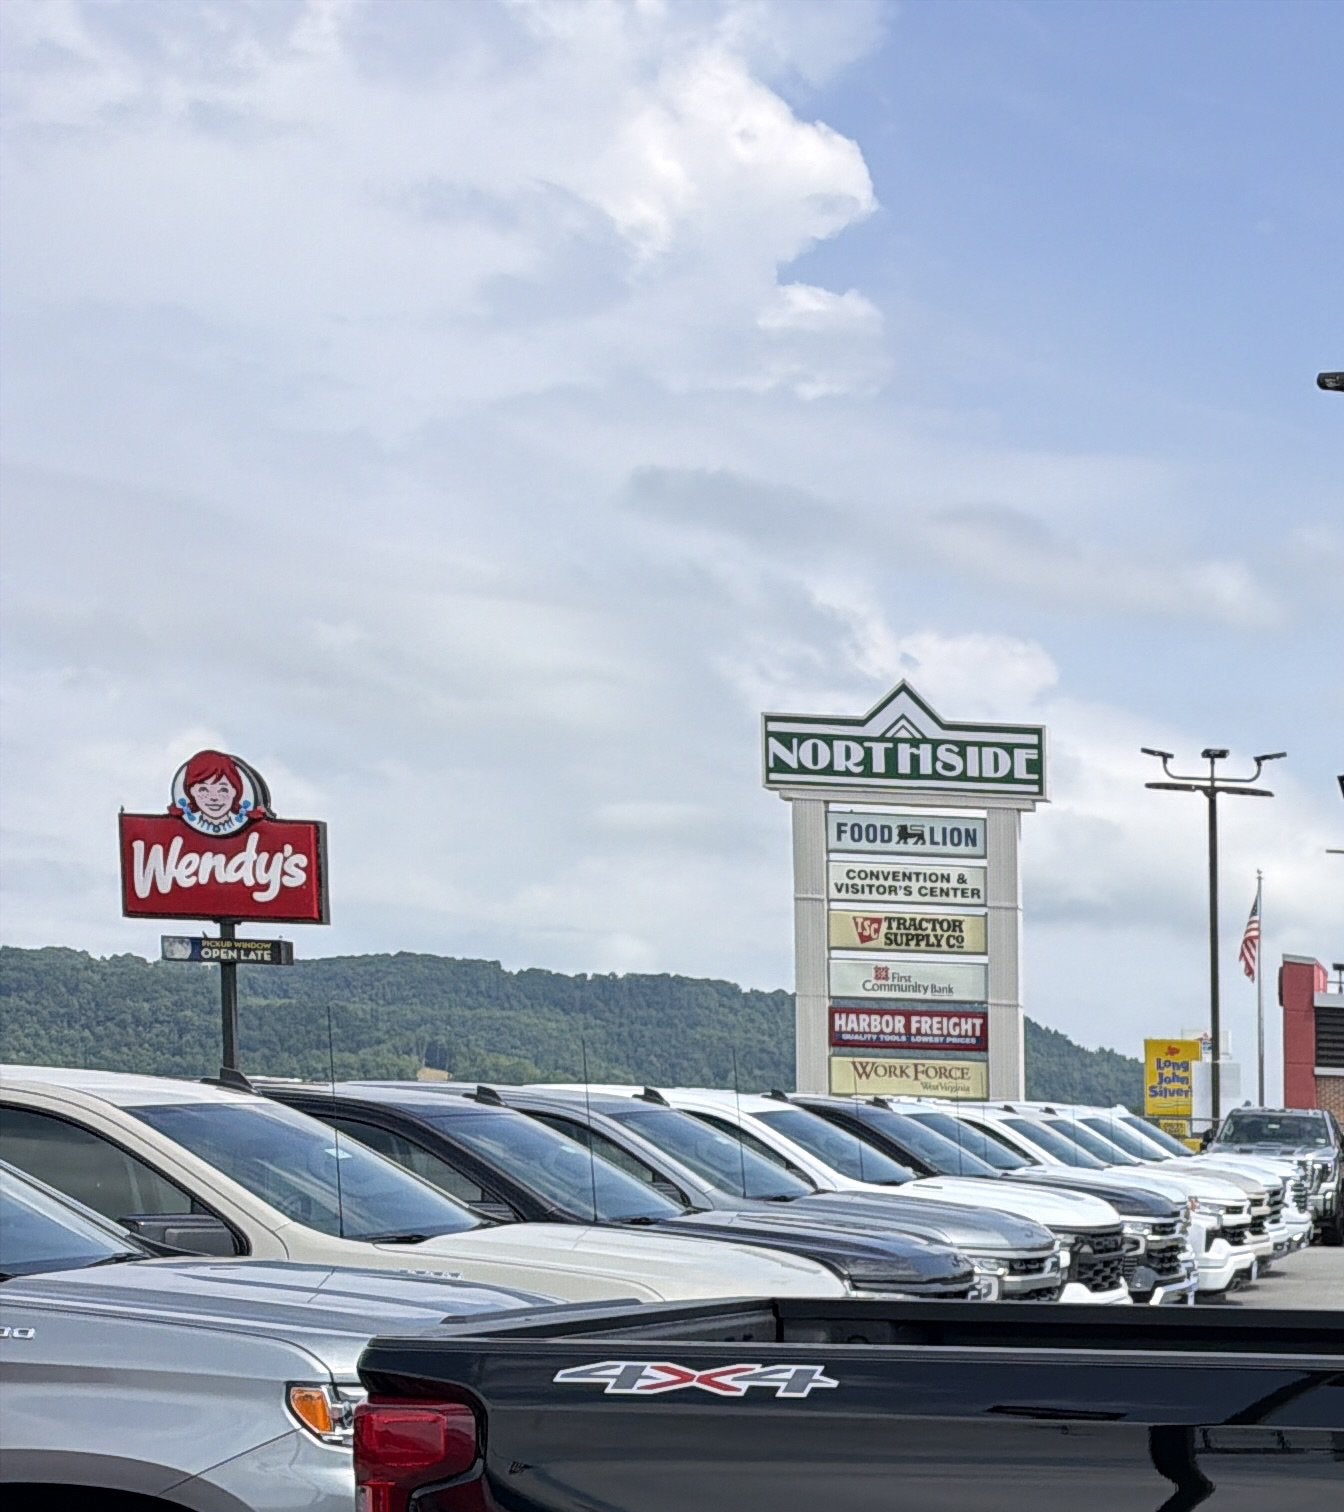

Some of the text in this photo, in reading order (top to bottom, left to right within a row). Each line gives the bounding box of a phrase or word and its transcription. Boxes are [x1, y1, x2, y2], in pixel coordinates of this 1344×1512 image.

[768, 737, 1039, 780] NORTHSIDE
[836, 822, 977, 847] FOOD LION
[132, 832, 308, 902] Wendy's
[845, 869, 968, 884] CONVENTION &
[834, 882, 981, 899] VISITOR'S CENTER
[855, 917, 879, 939] TSC
[884, 916, 964, 933] TRACTOR
[234, 941, 272, 949] WINDOW
[884, 932, 944, 947] SUPPLY
[200, 948, 272, 961] OPEN LATE
[891, 972, 912, 983] First
[862, 979, 954, 996] Community Bank
[834, 1013, 984, 1037] HARBOR FREIGHT
[1156, 1058, 1190, 1072] Long
[1158, 1072, 1190, 1086] John
